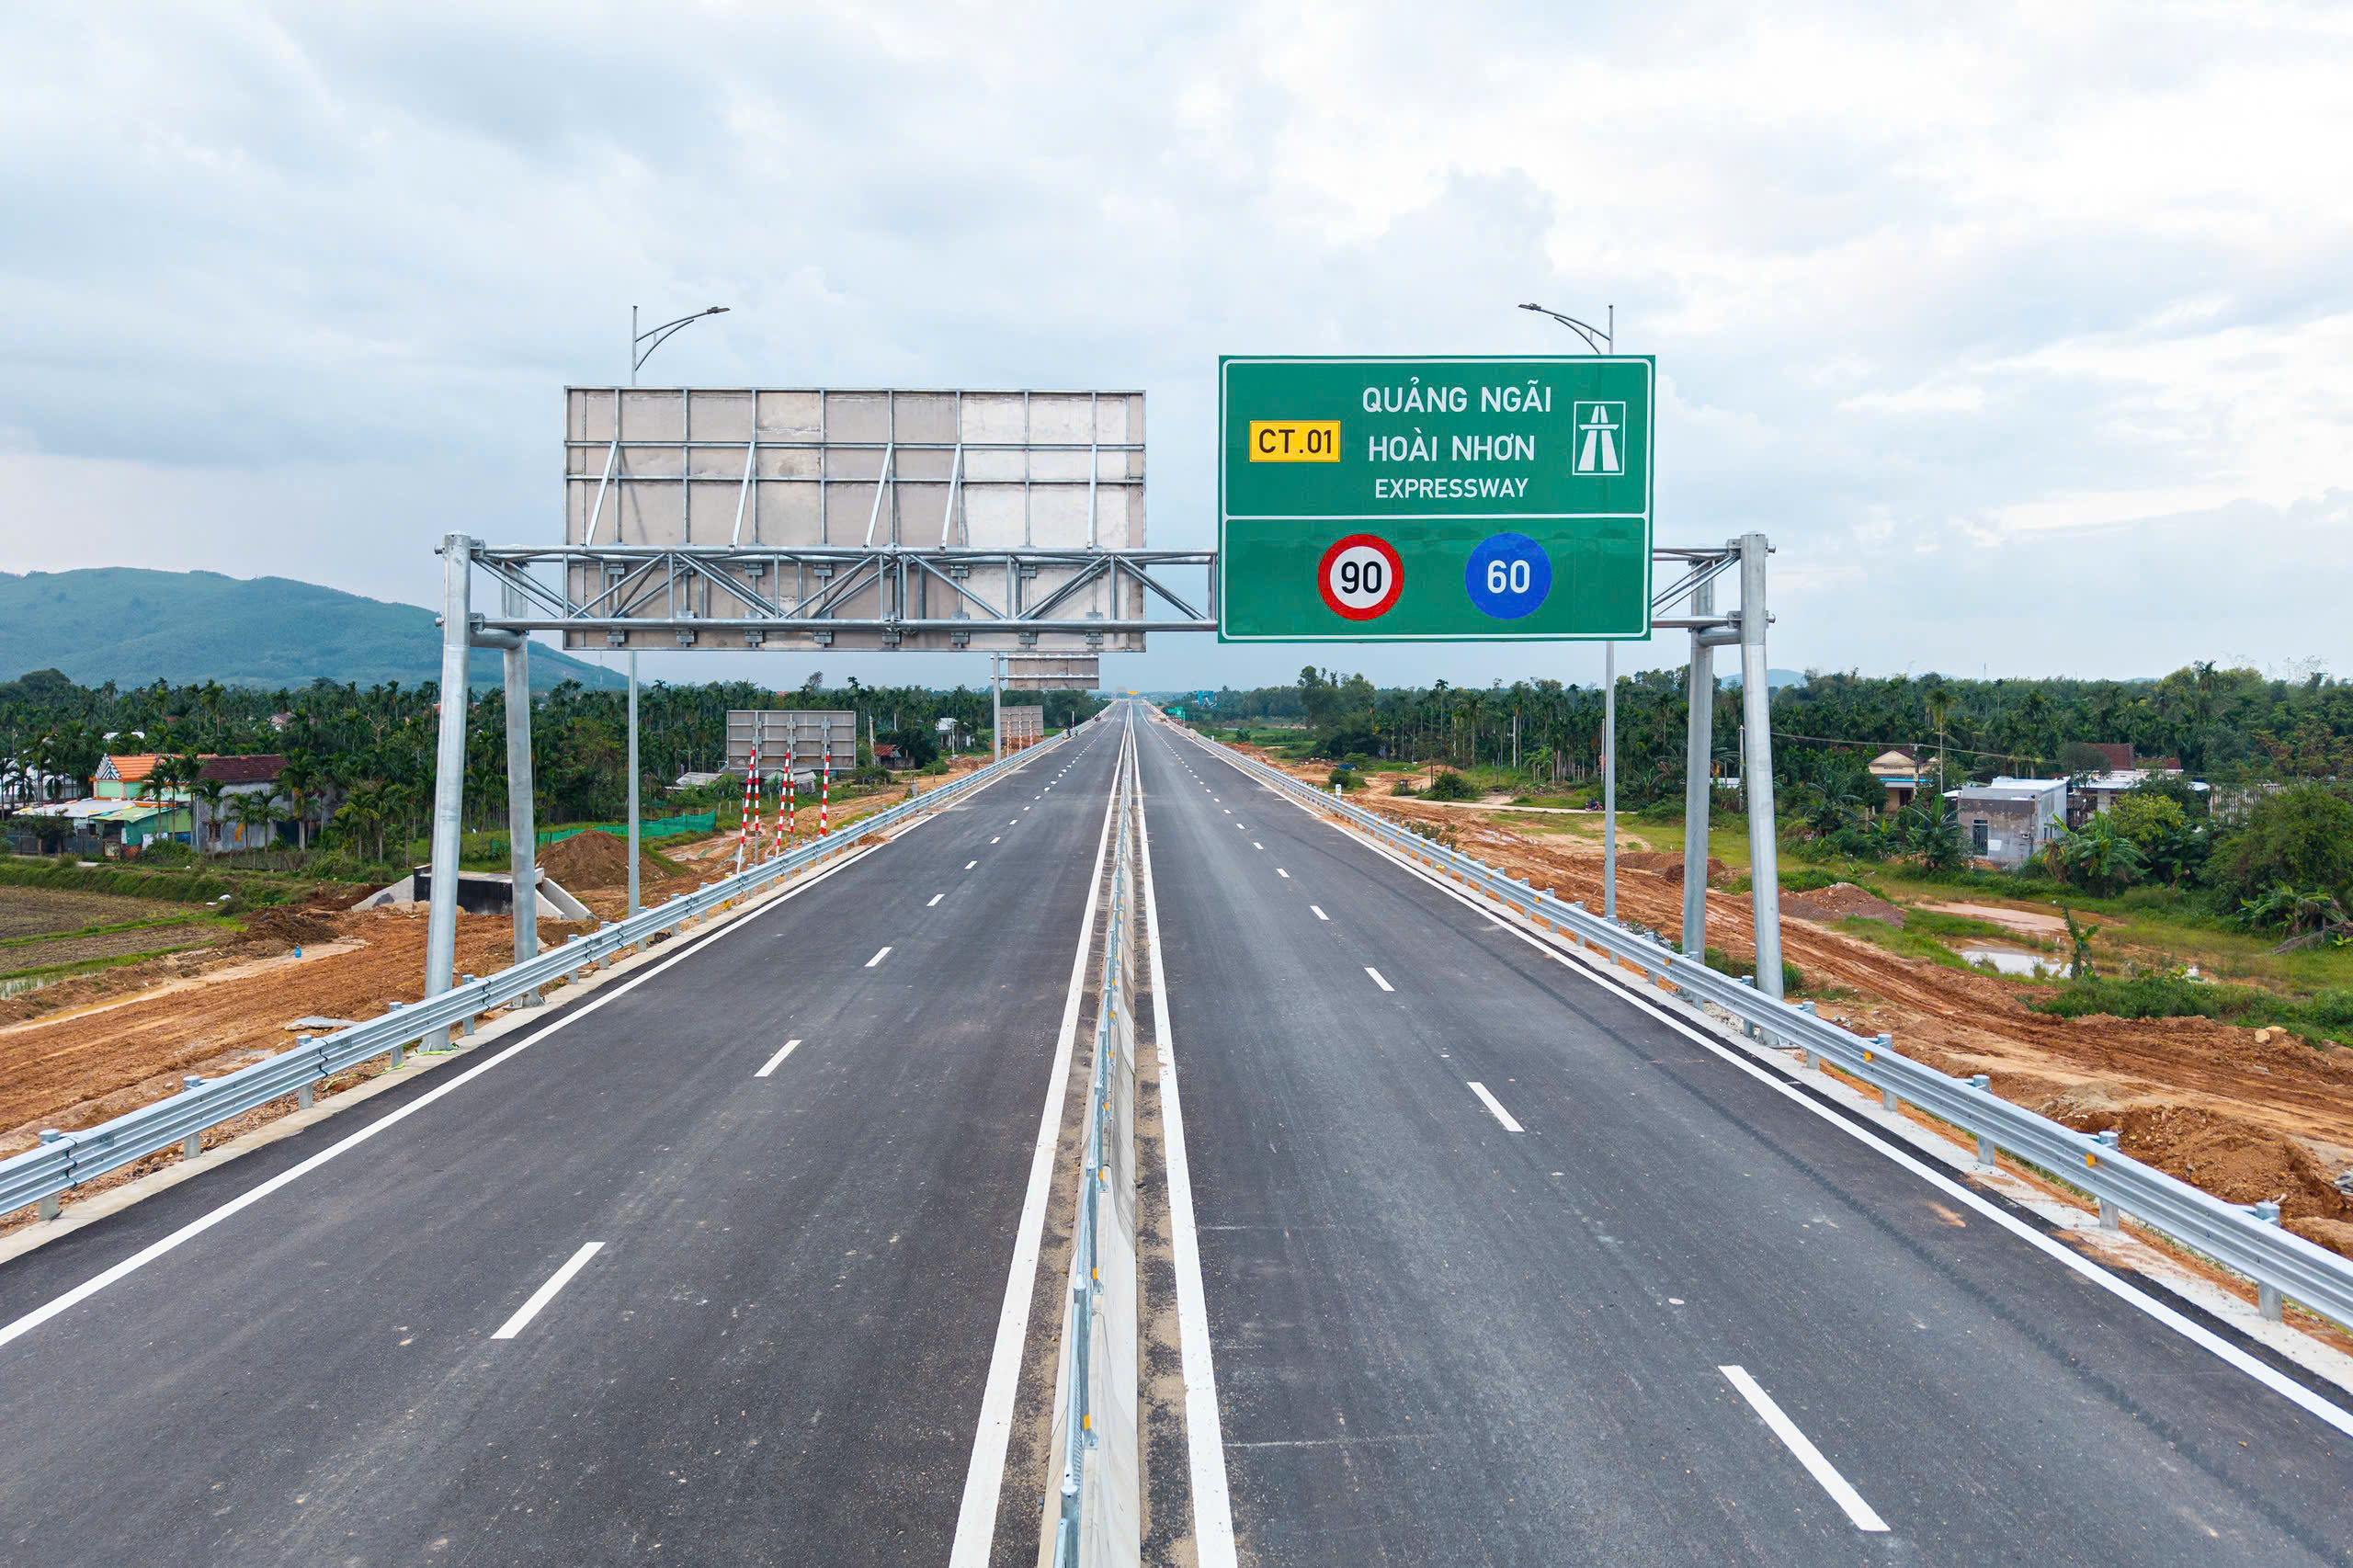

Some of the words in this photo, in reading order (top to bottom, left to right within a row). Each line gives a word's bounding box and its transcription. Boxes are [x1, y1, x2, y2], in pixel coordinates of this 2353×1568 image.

[1362, 376, 1468, 413] QUẢNG
[1481, 379, 1552, 413] NGÃI
[1258, 428, 1332, 454] CT.01
[1369, 426, 1438, 462] HOÀI
[1451, 433, 1535, 461] NHƠN
[1375, 477, 1529, 499] EXPRESSWAY
[1340, 561, 1382, 595] 90
[1487, 559, 1530, 594] 60
